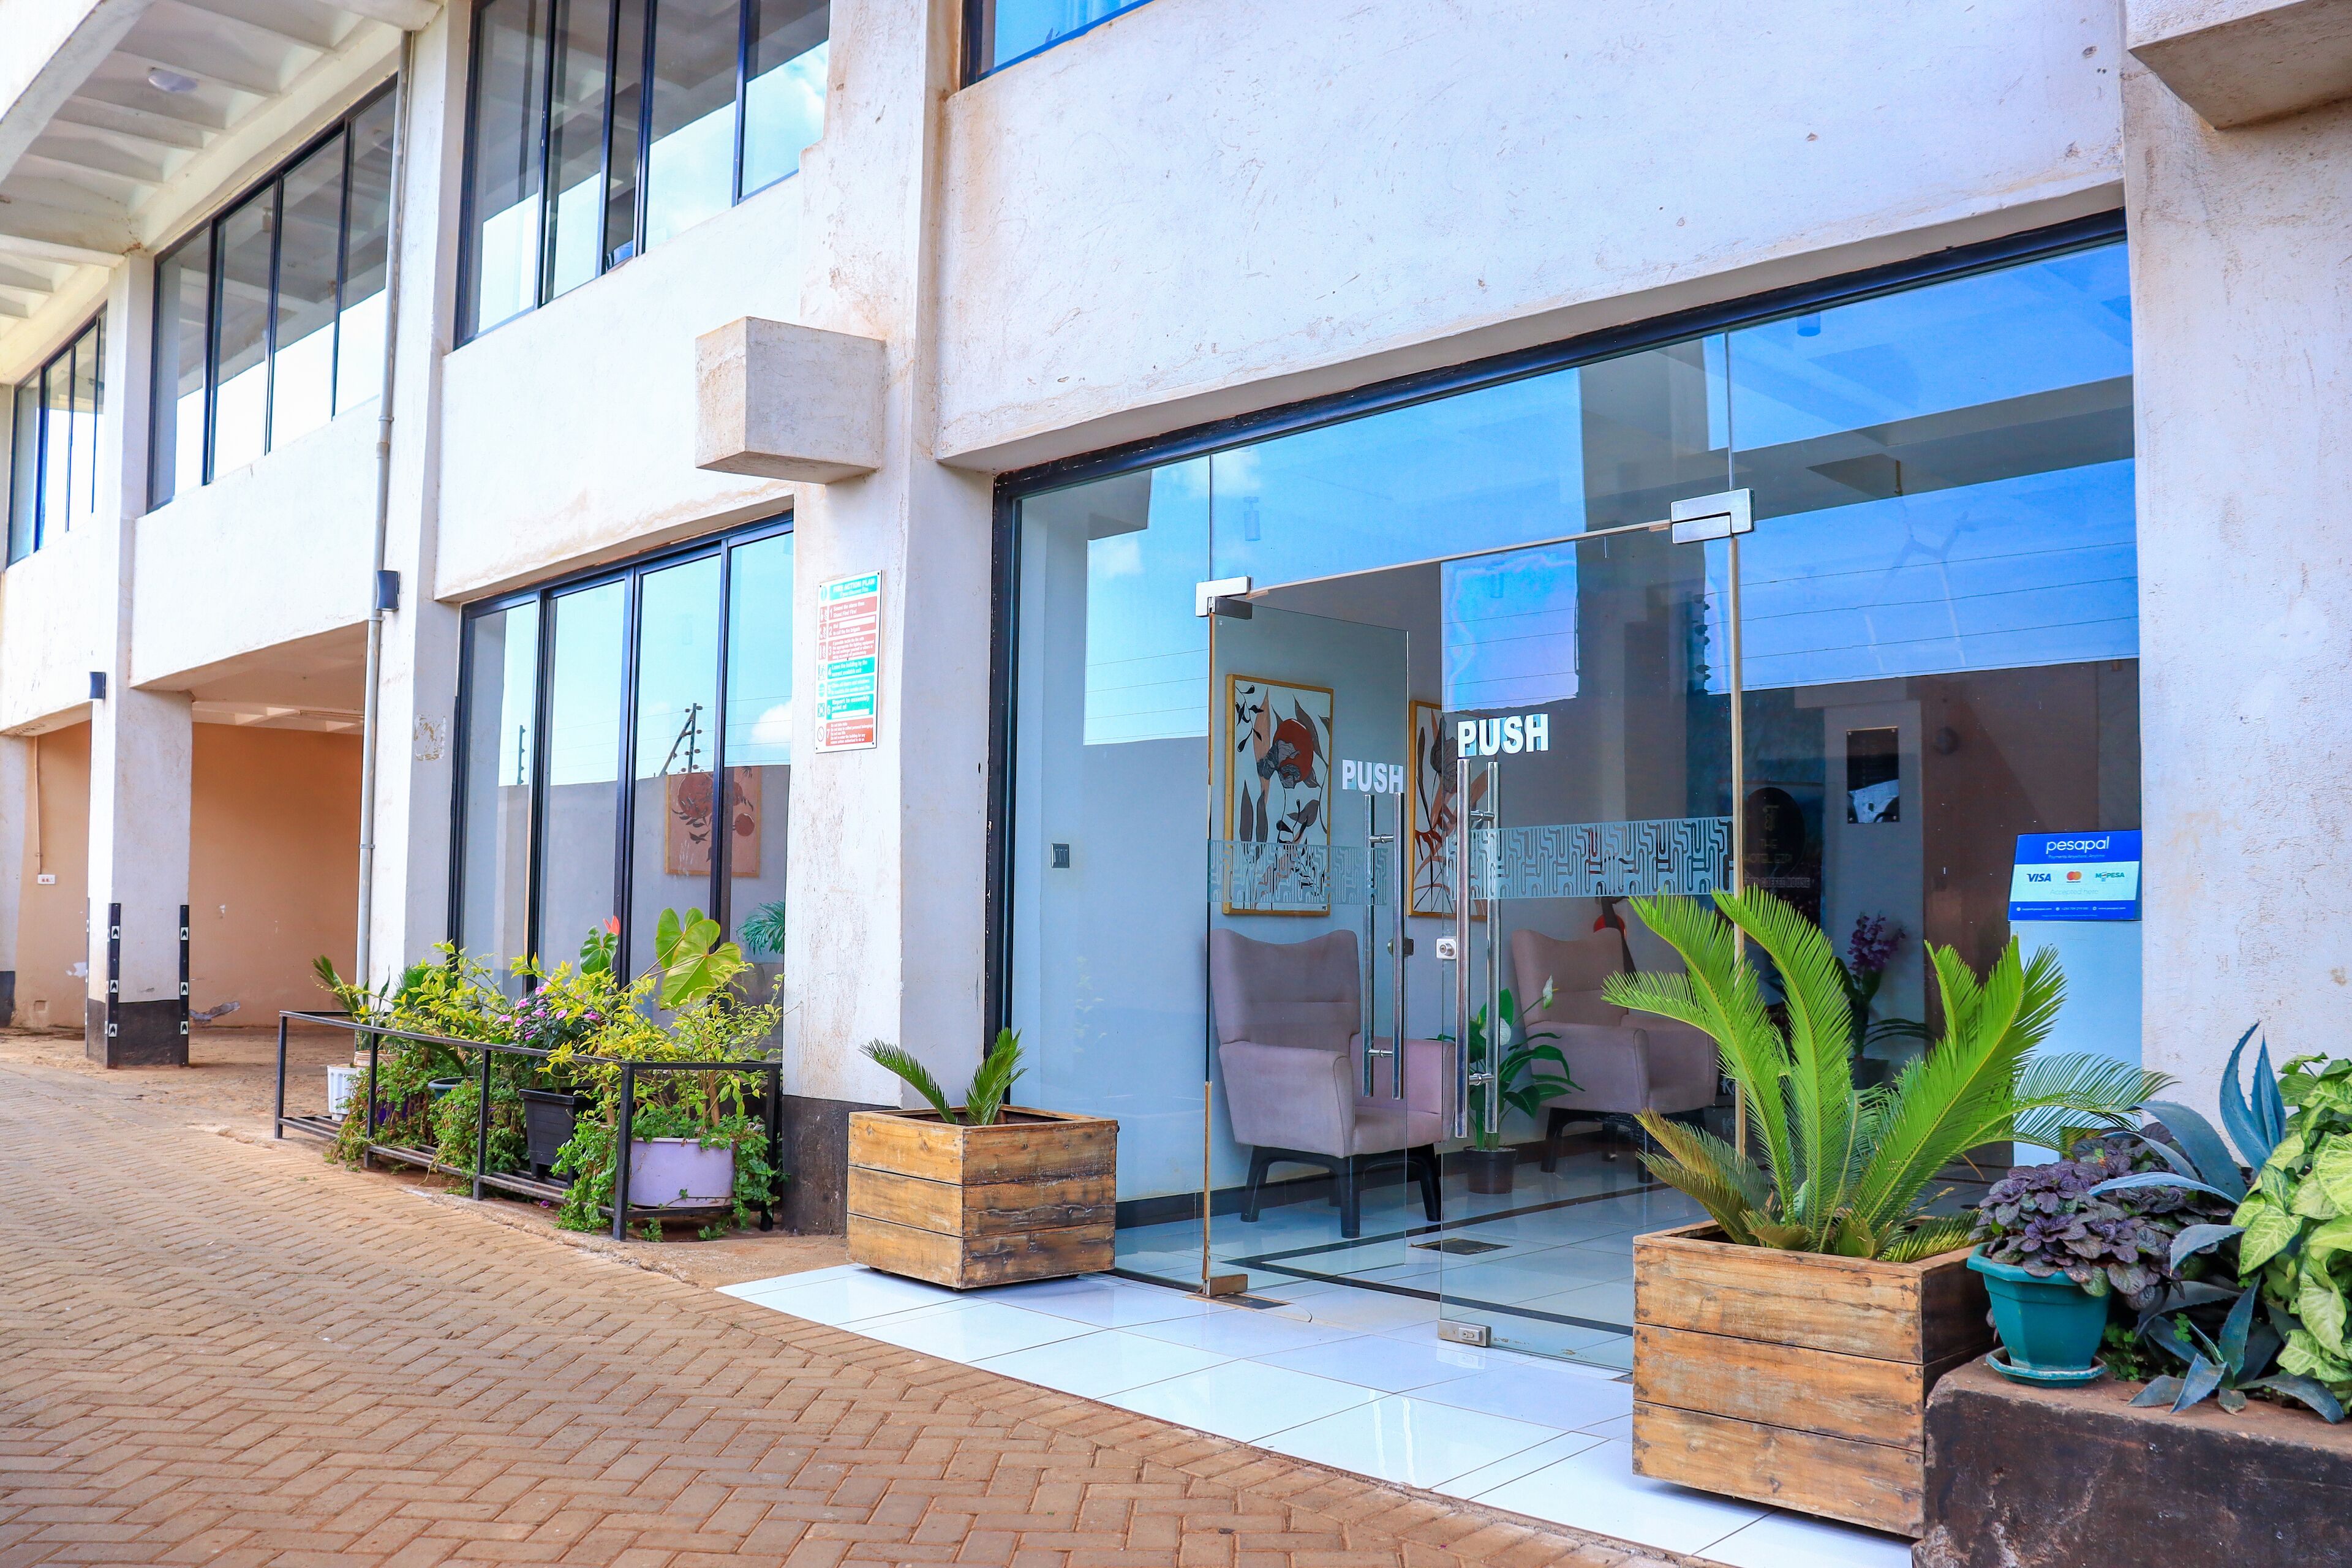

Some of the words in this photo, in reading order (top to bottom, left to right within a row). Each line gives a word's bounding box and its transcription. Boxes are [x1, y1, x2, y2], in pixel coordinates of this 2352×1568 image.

[844, 581, 862, 590] ACTION
[829, 608, 832, 617] 1
[829, 626, 832, 636] 2
[829, 646, 832, 655] 3
[828, 667, 831, 677] 4
[827, 705, 831, 715] 6
[1457, 713, 1548, 758] PUSH
[1342, 760, 1404, 794] PUSH
[1759, 839, 1778, 849] THE
[2046, 836, 2109, 854] pesapal
[1788, 877, 1811, 888] HOUSE
[2027, 873, 2051, 882] VISA
